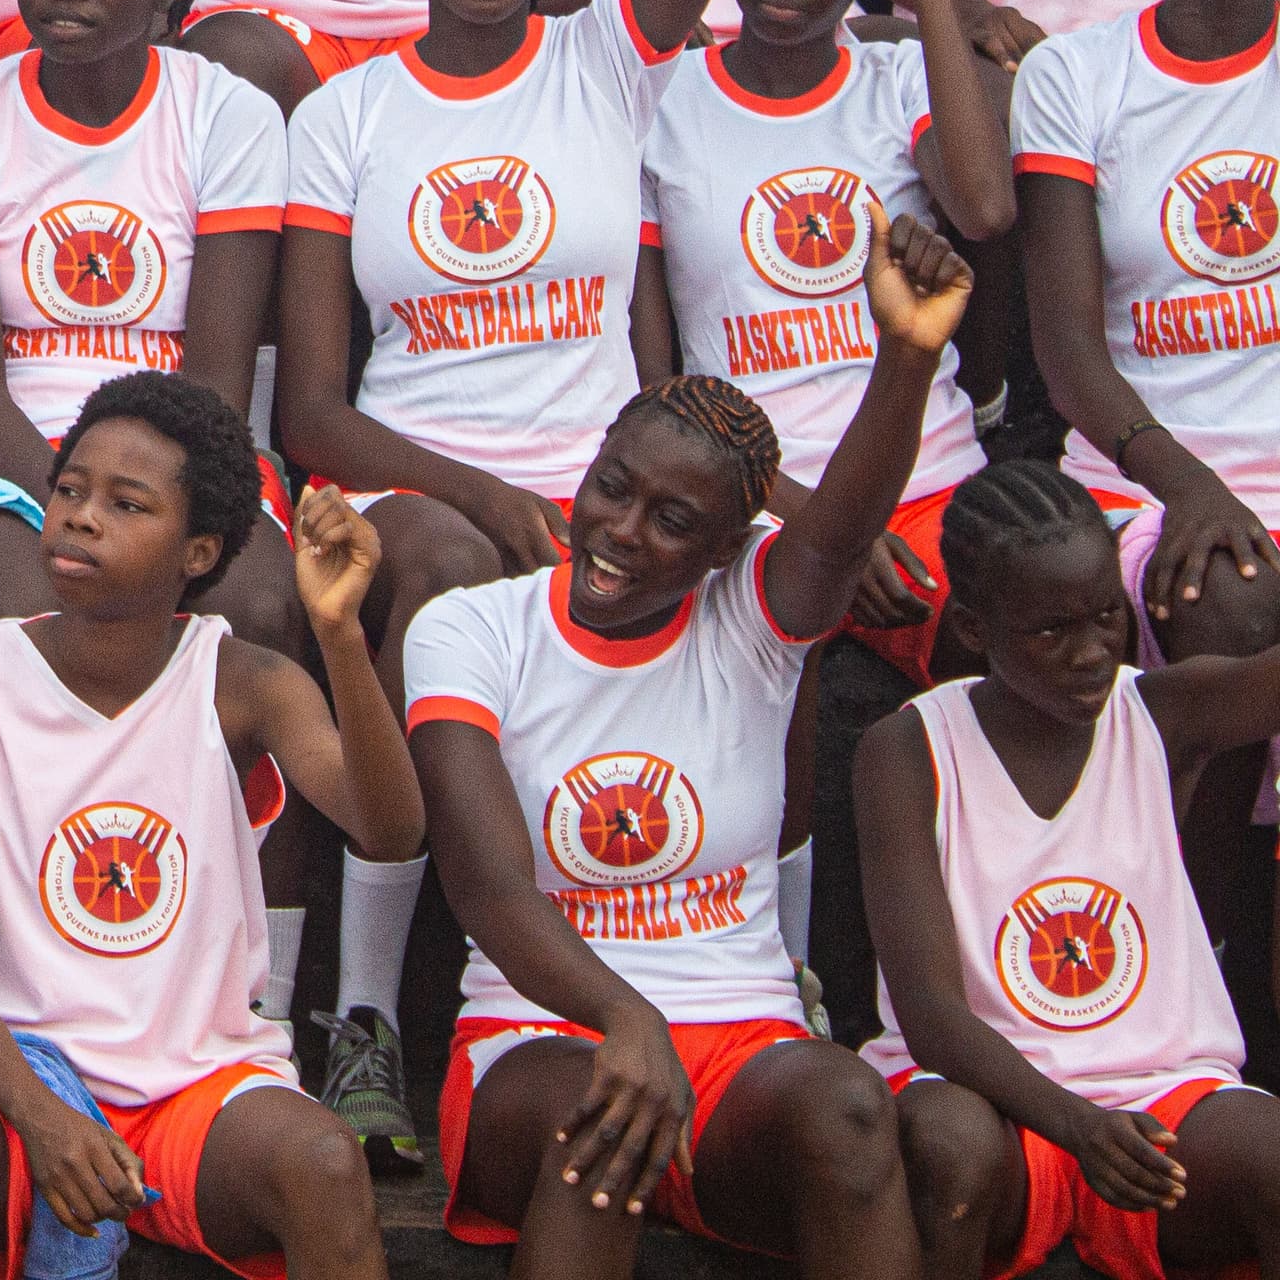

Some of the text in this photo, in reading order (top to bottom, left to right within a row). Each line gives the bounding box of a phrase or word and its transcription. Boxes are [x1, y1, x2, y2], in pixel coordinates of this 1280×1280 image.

[546, 275, 606, 341] CAMP
[722, 302, 875, 378] BASKETBALL
[54, 853, 179, 944] VICTORIA'S QUEENS BASKETBALL FOUNDATION
[1009, 922, 1134, 1018] VICTORIA'S QUEENS BASKETBALL FOUNDATION
